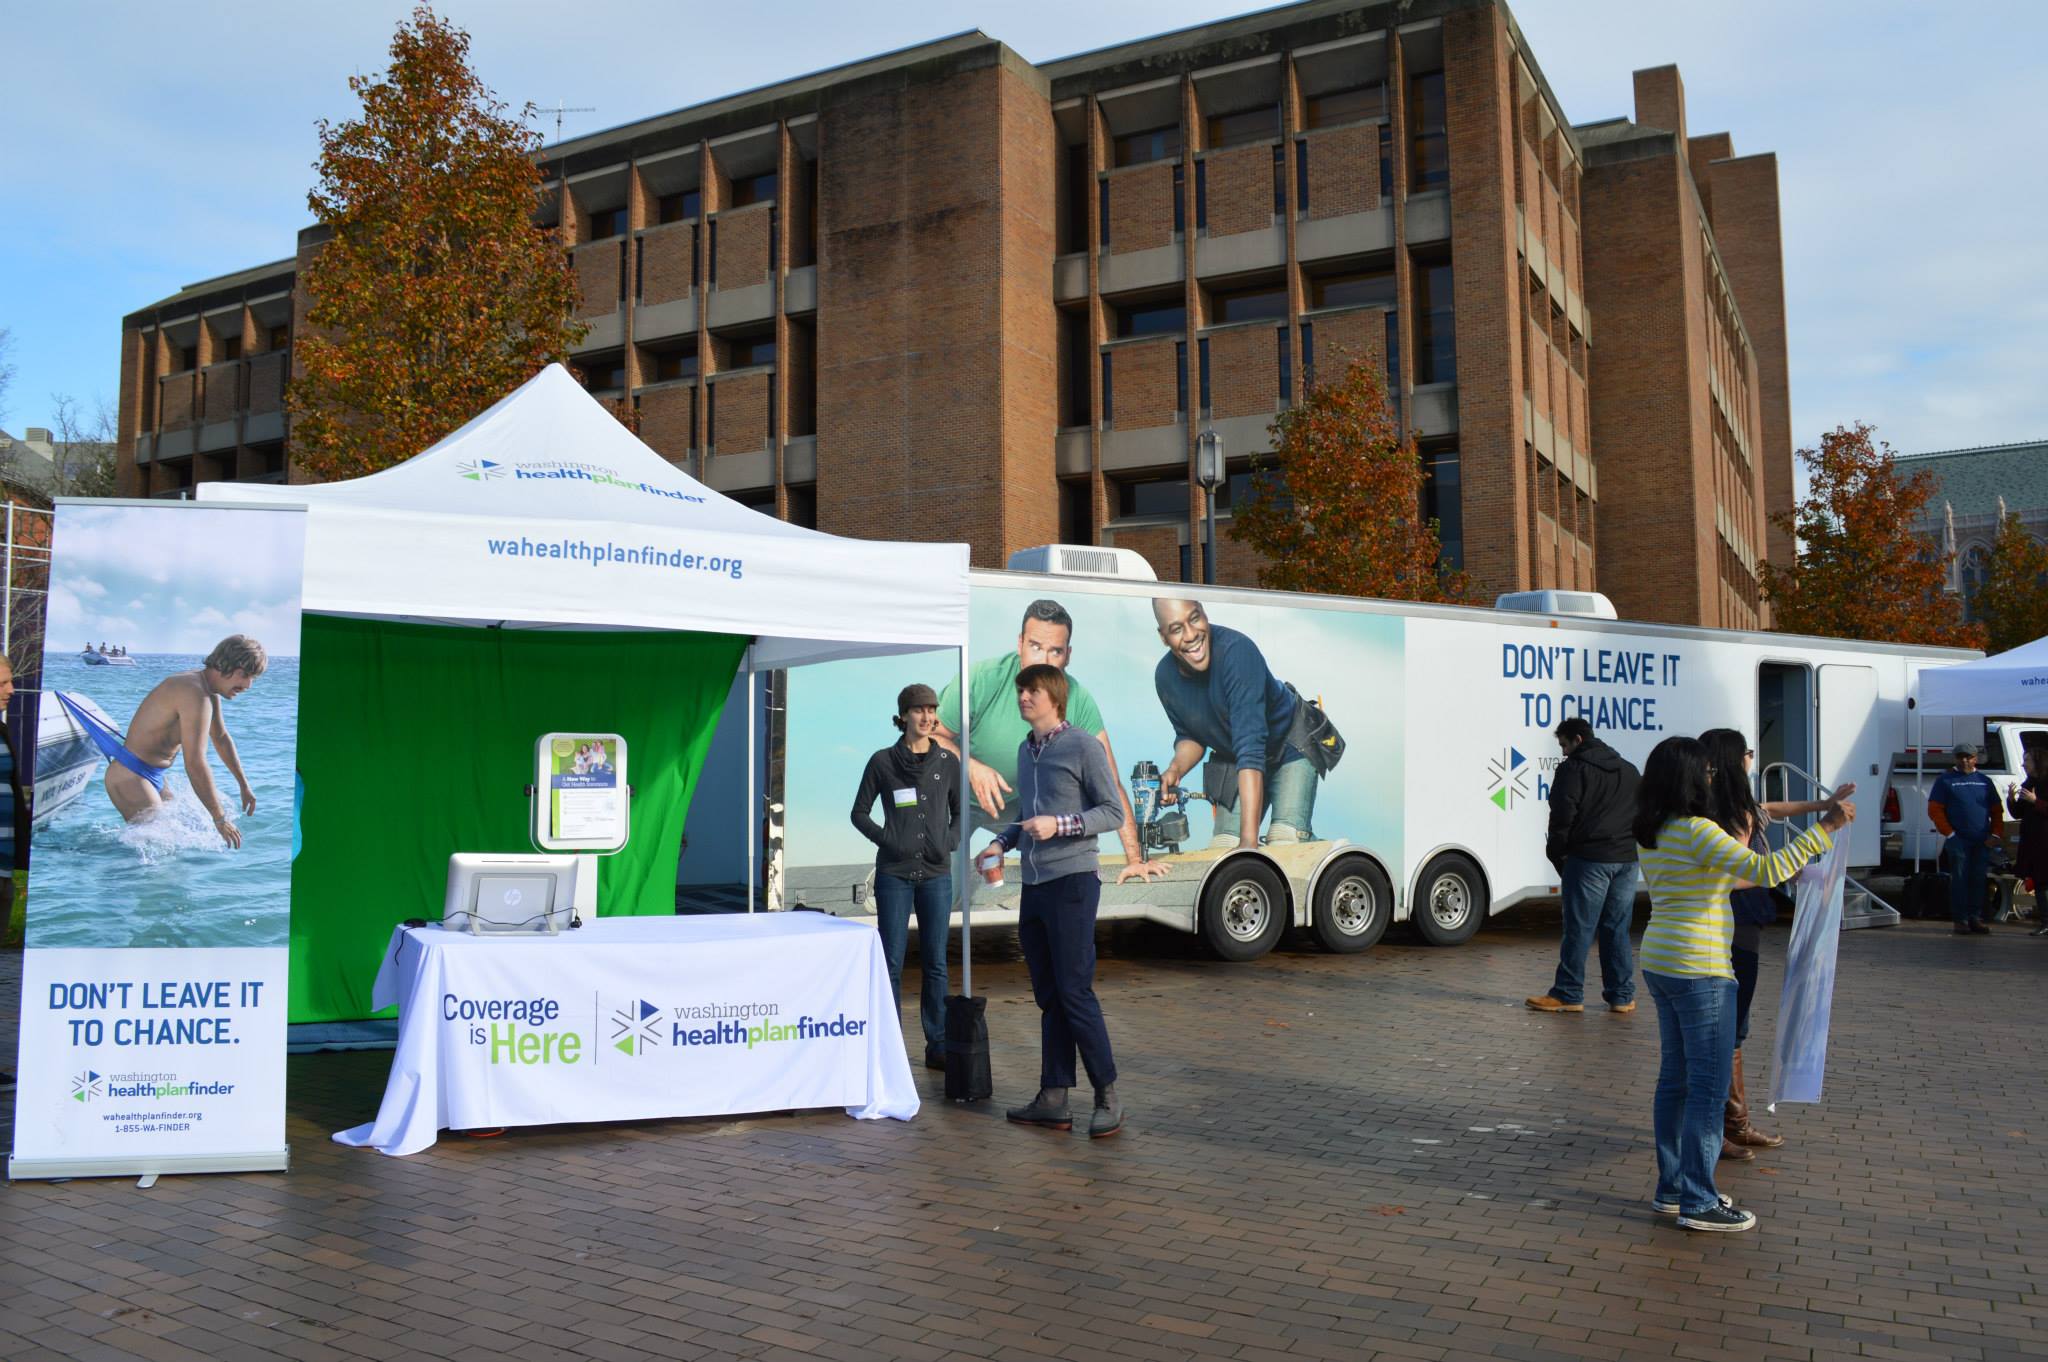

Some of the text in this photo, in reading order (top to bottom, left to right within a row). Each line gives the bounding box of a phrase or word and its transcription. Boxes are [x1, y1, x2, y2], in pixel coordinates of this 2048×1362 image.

[515, 461, 619, 476] washington
[516, 469, 706, 504] healthplanfinder
[488, 537, 743, 579] wahealthplanfinder.org
[1503, 643, 1681, 687] DON'T LEAVE IT
[1520, 692, 1664, 731] TO CHANCE.
[49, 981, 264, 1010] DON'T LEAVE IT
[443, 993, 559, 1026] Coverage
[674, 1001, 779, 1021] washington
[68, 1018, 240, 1046] TO CHANCE.
[469, 1022, 581, 1065] is Here
[672, 1013, 867, 1050] healthplanfinder
[108, 1082, 235, 1100] healthplanfinder
[110, 1072, 177, 1085] washington
[103, 1111, 202, 1122] wahealthplanfinder.org
[115, 1123, 190, 1133] 1-855-WA-FINDER
